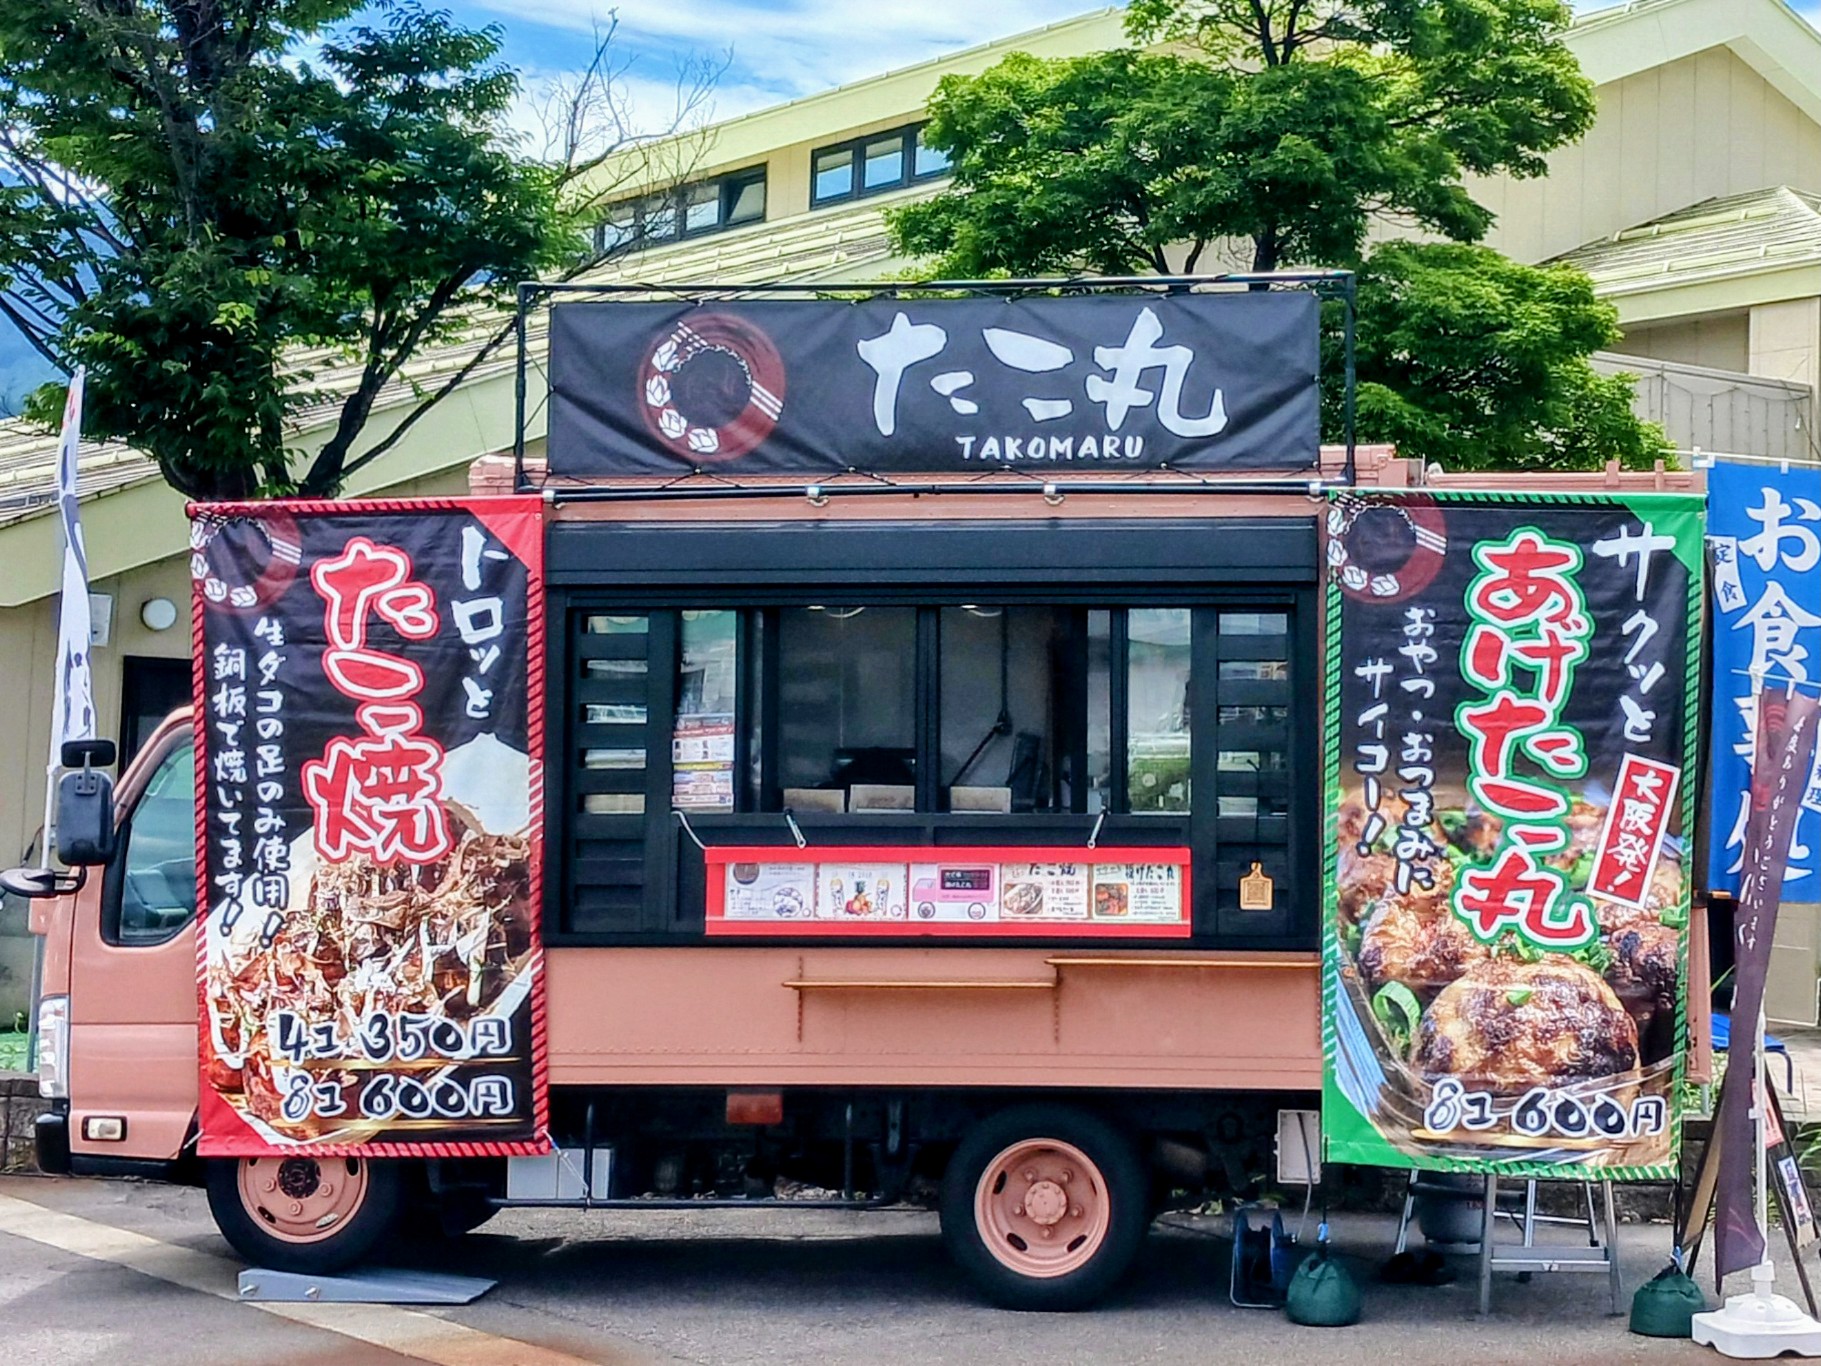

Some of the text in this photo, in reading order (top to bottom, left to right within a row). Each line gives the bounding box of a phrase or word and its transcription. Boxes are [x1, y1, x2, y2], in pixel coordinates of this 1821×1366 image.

[857, 307, 1228, 436] たこ丸
[956, 435, 1145, 461] TAKOMARU
[302, 538, 454, 864] たこ焼
[452, 525, 509, 718] トロッと
[1592, 521, 1676, 742] サクッと
[1396, 607, 1439, 894] おやつ・おつまみに
[1452, 528, 1598, 948] あげたこ丸
[358, 1012, 512, 1064] 350円
[360, 1073, 514, 1119] 600円
[1512, 1087, 1666, 1138] 600円
